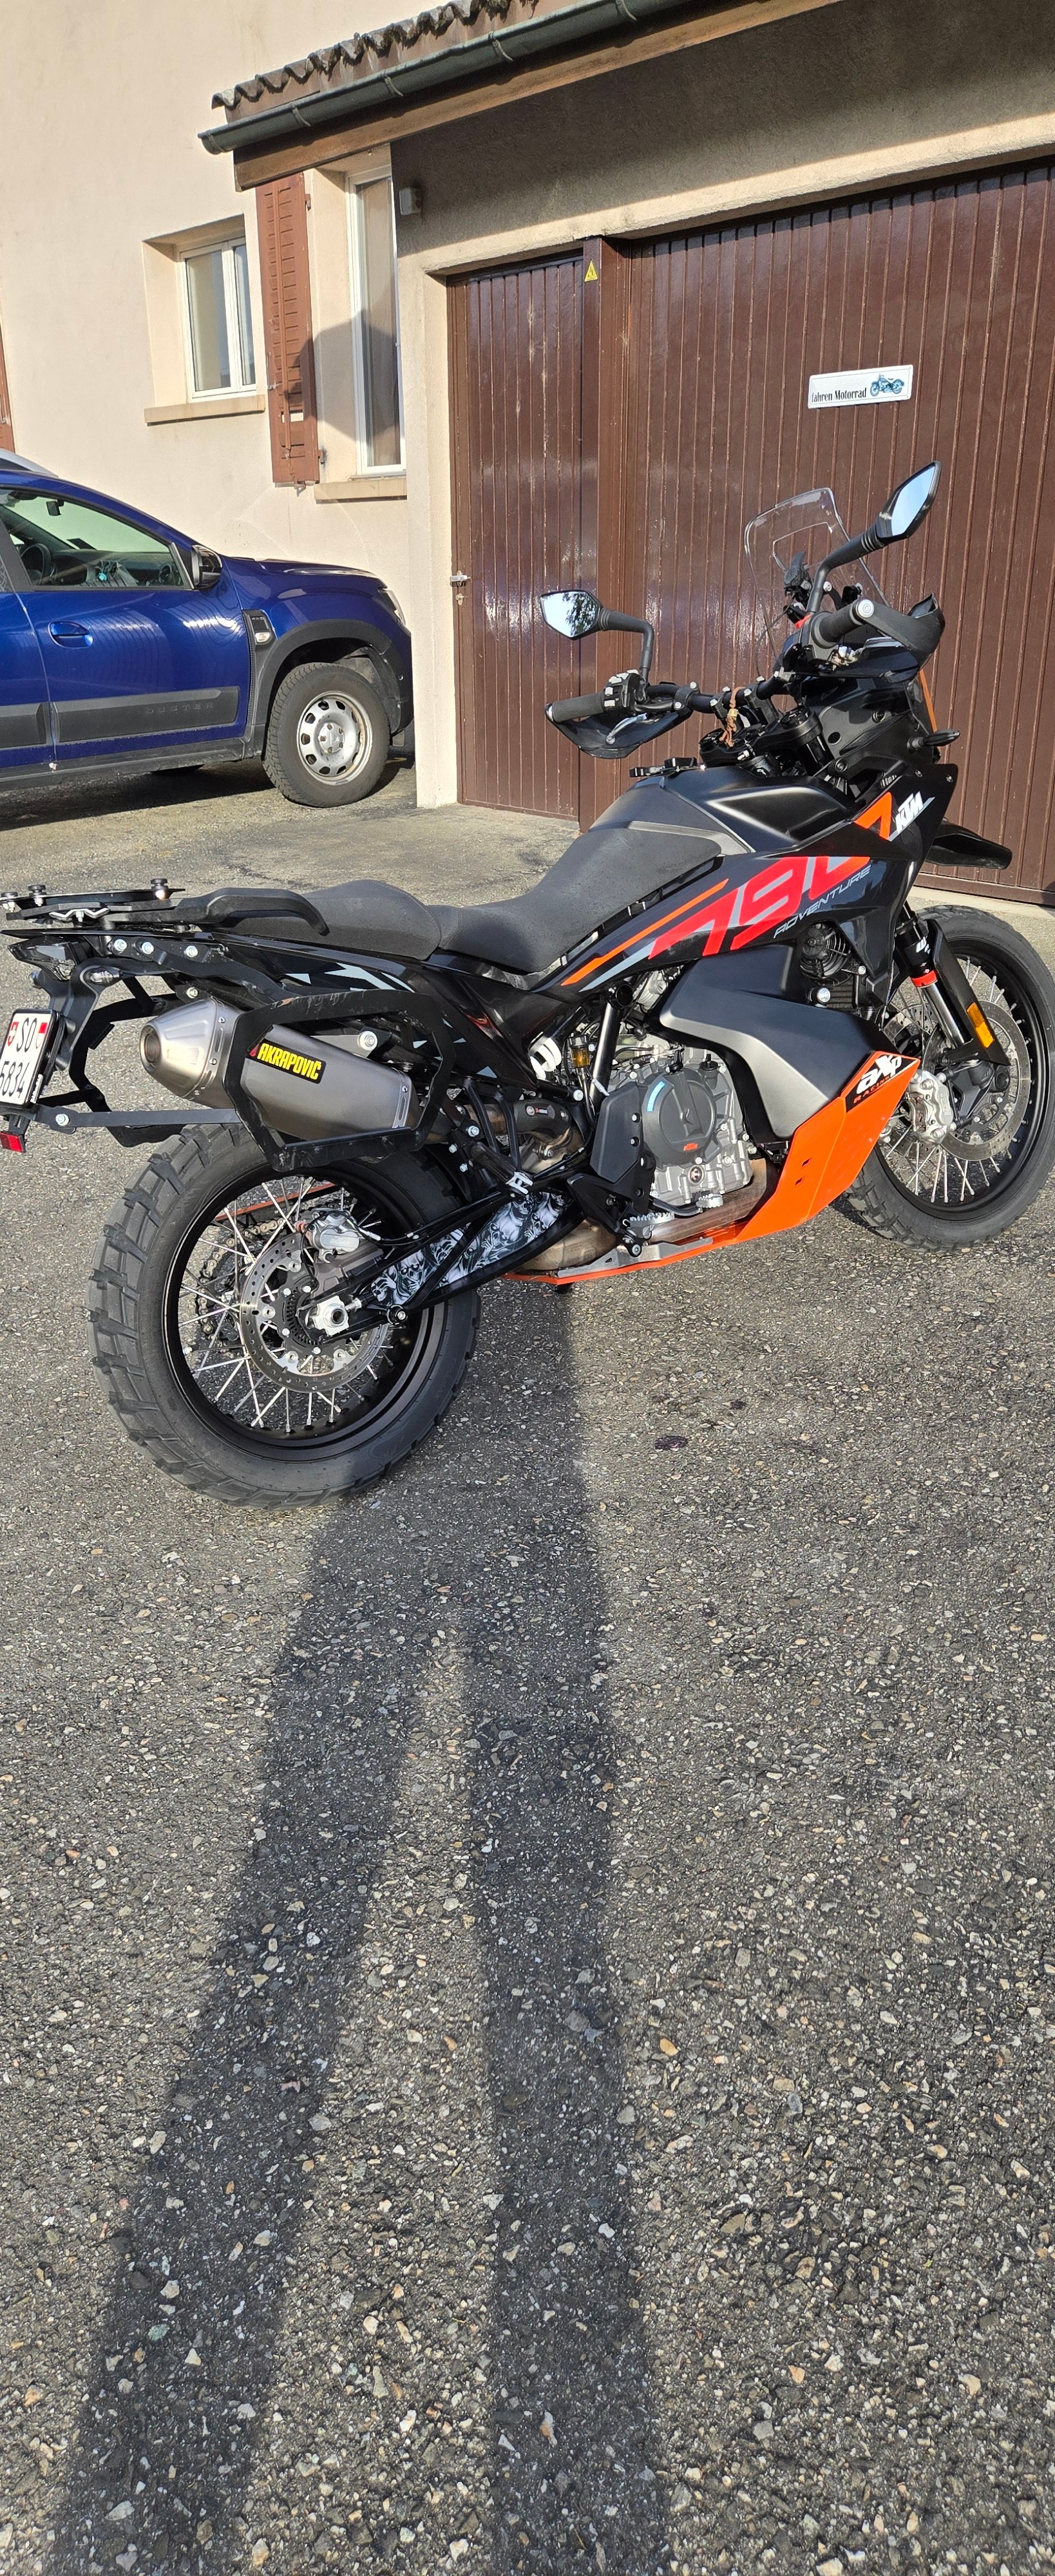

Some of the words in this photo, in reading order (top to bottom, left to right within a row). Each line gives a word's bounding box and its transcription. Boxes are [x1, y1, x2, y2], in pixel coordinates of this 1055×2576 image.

[835, 387, 867, 401] Motorrad
[895, 791, 923, 833] KTM
[774, 864, 871, 939] ADVENTURE
[16, 1017, 37, 1052] SO
